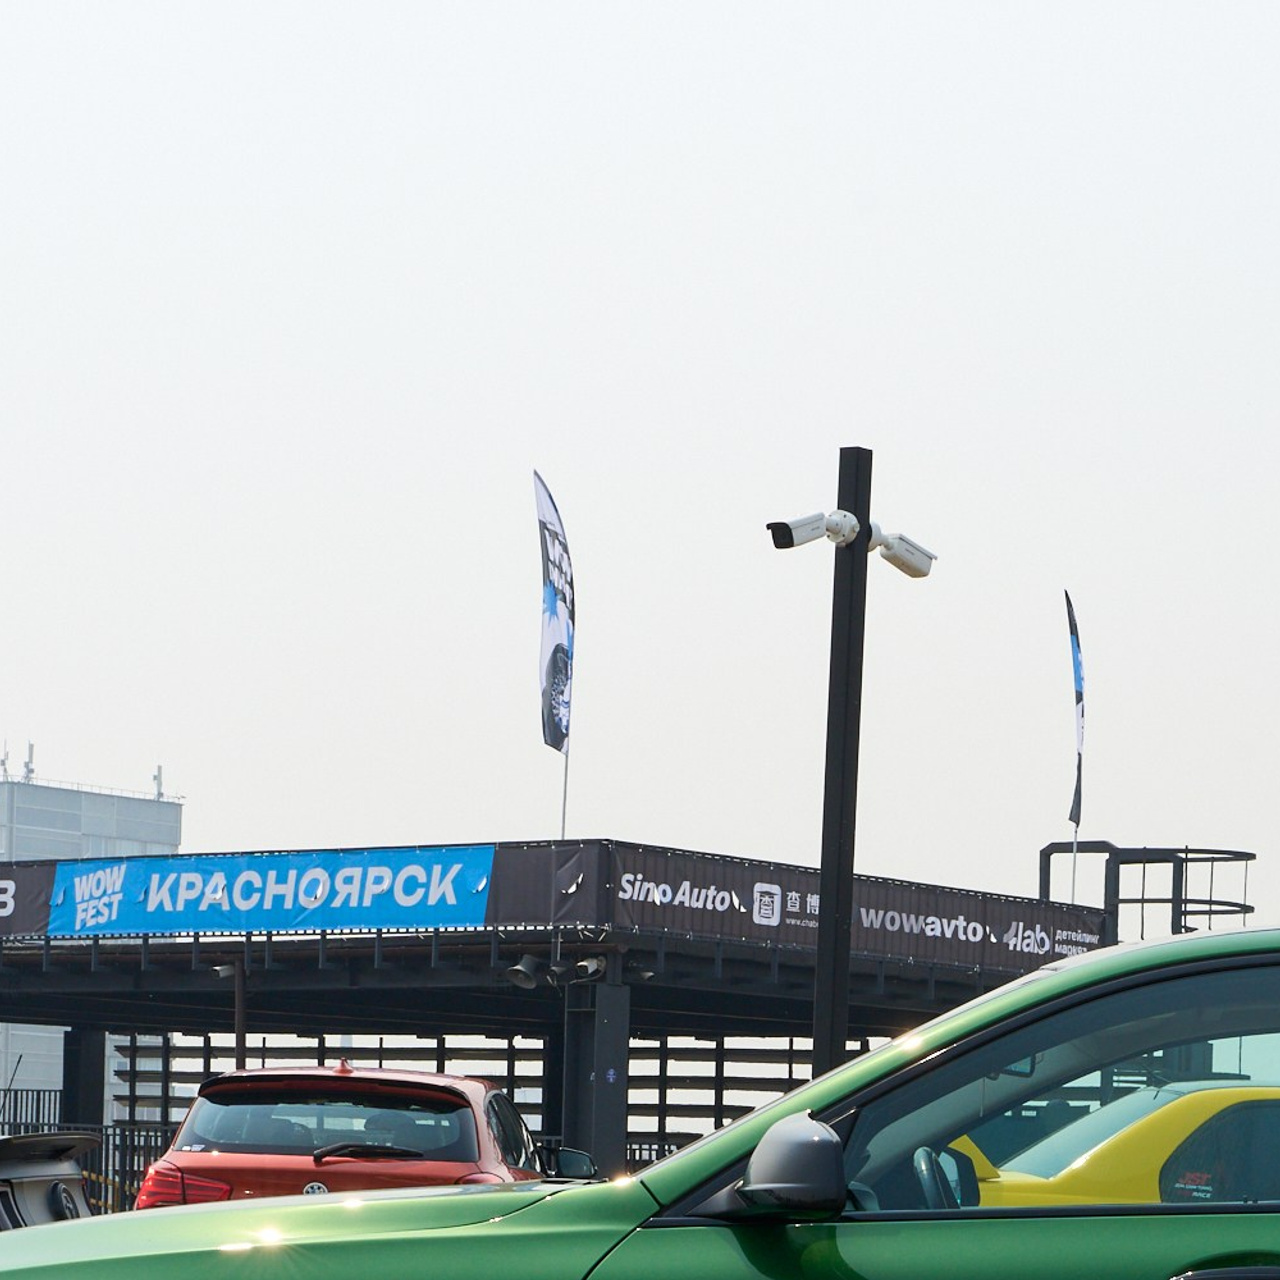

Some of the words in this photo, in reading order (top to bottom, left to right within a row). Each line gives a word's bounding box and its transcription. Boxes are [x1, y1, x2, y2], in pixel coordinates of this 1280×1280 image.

[74, 864, 126, 903] WOW
[146, 864, 463, 912] КРАСНОЯРСК
[618, 873, 672, 906] Sino
[673, 880, 731, 912] Auto
[75, 893, 123, 931] FEST
[860, 907, 983, 942] wowavto
[1003, 922, 1050, 955] 4lab
[1055, 930, 1100, 945] детейлинг
